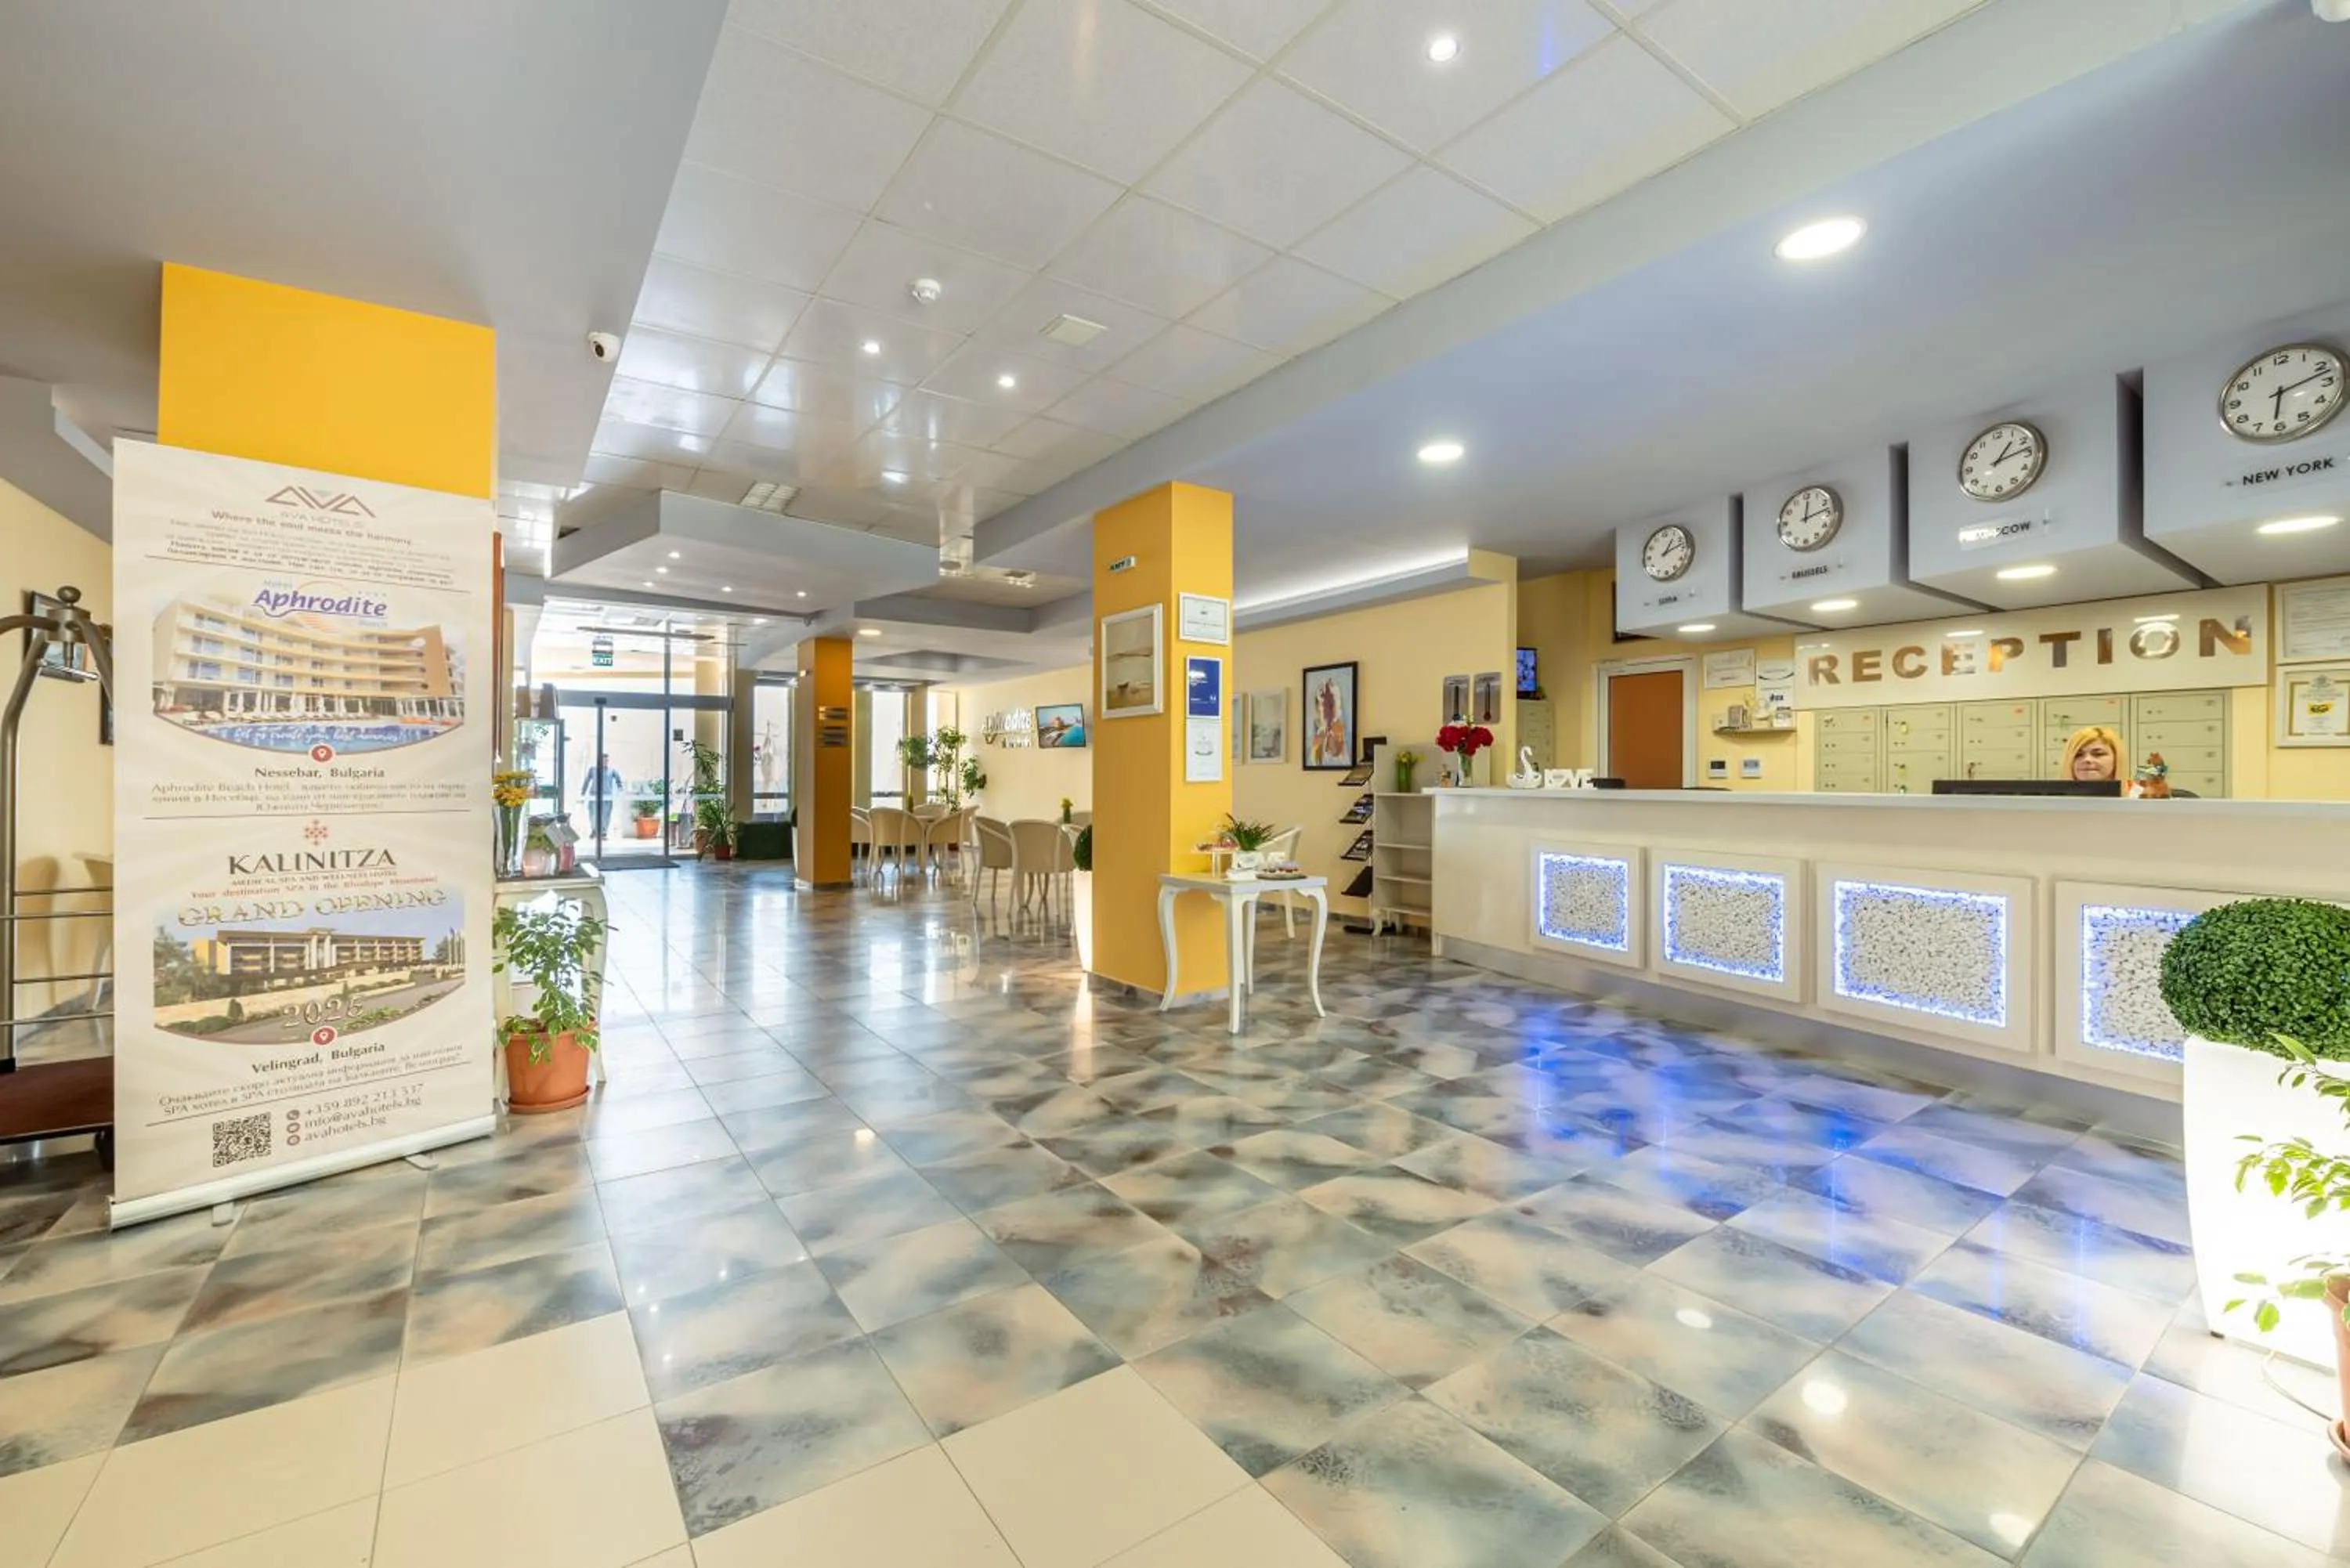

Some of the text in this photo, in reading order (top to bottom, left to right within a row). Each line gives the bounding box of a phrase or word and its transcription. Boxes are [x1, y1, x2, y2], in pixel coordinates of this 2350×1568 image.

[2274, 355, 2290, 366] 12
[2253, 367, 2262, 376] 11
[2314, 361, 2327, 372] 2
[2237, 381, 2249, 392] 10
[2321, 376, 2334, 387] 3
[2229, 399, 2241, 409] 9
[2314, 395, 2326, 404] 4
[2236, 414, 2249, 423] 8
[2298, 411, 2309, 422] 5
[2253, 422, 2263, 432] 7
[2274, 421, 2286, 431] 6
[2243, 457, 2335, 486] NEW YORK
[254, 588, 387, 616] Aphrodite
[1807, 614, 2252, 687] RECEPTION
[255, 767, 385, 779] Nessebar, Bulgaria
[228, 848, 397, 875] KALINITZA
[178, 888, 447, 927] GRAND OPENING
[252, 1042, 385, 1074] Velingrad, Bulgaria
[304, 1115, 387, 1141] avahotels.bg
